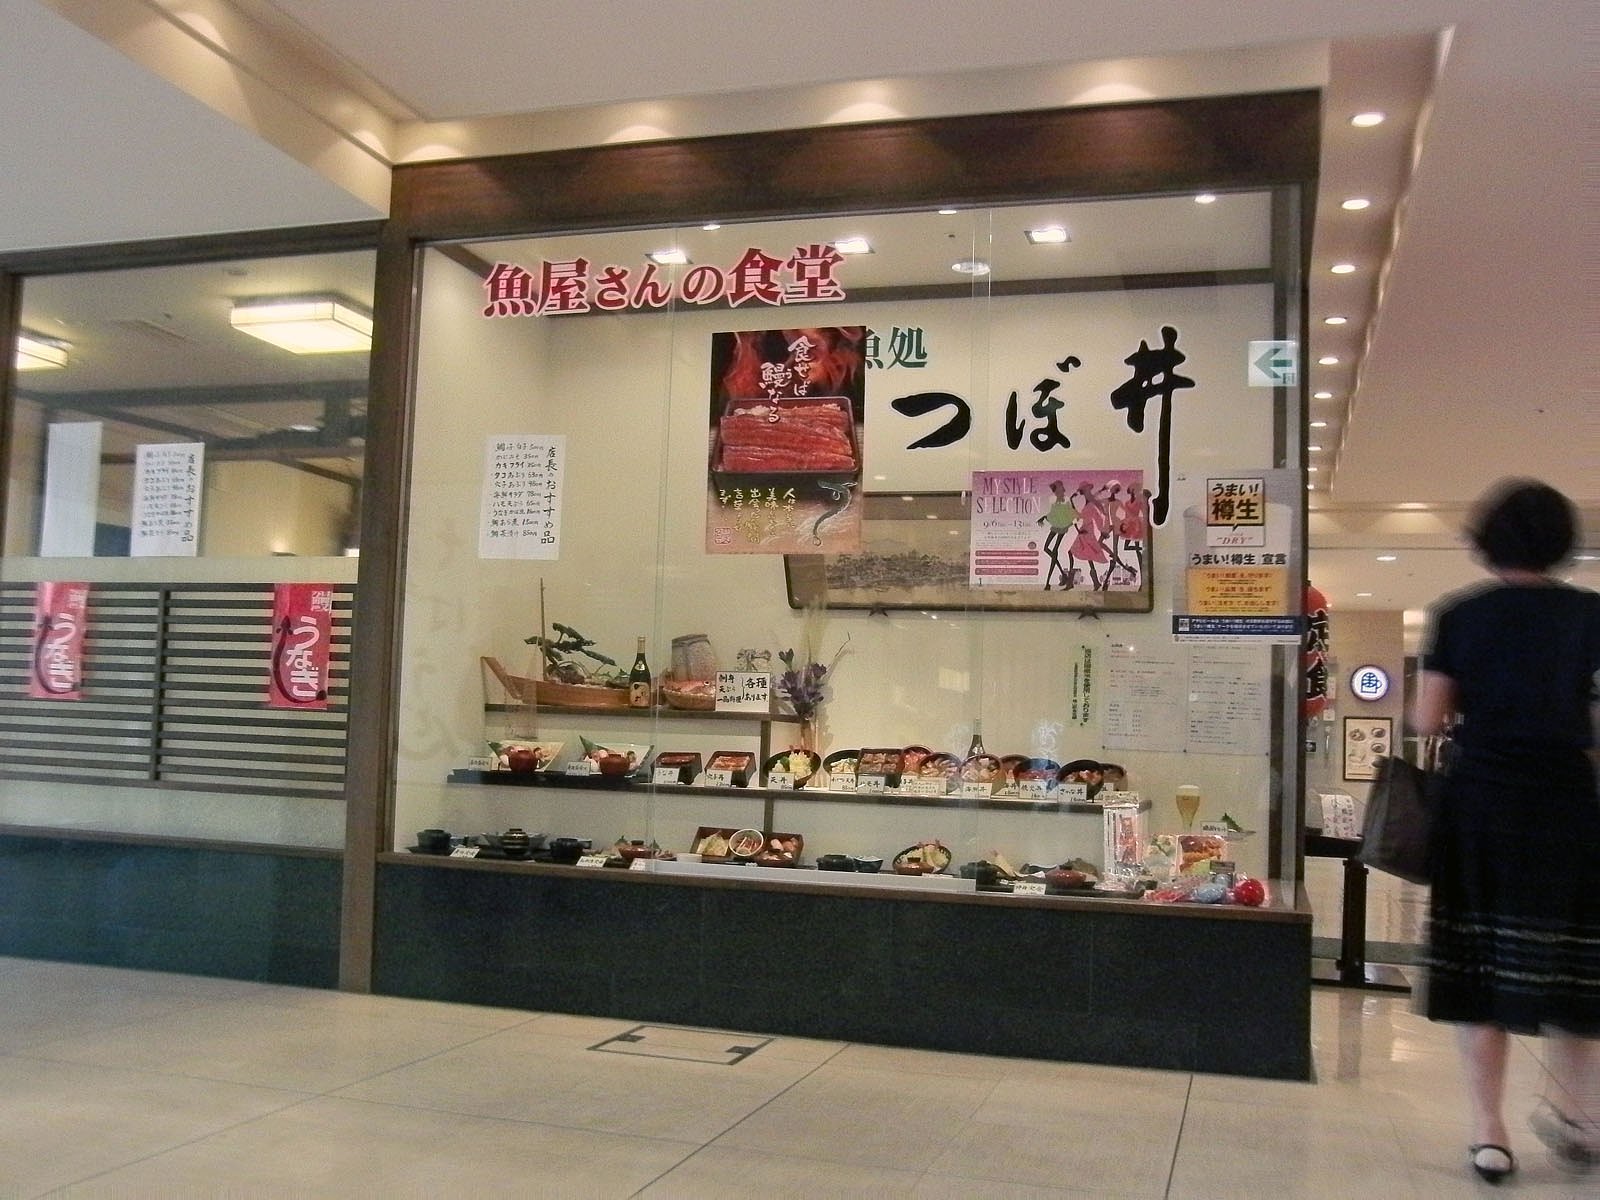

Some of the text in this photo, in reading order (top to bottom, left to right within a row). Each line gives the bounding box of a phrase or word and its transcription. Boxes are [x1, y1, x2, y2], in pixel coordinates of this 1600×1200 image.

[483, 244, 846, 317] 魚屋さんの食堂
[788, 335, 817, 396] 食せば
[759, 362, 788, 423] 鰻なる
[891, 326, 1195, 526] つぼ井
[496, 461, 525, 469] カキフライ
[541, 446, 558, 544] 店長のおすすめ品
[983, 476, 1038, 495] MY STYLE
[1212, 483, 1259, 498] うまい!
[976, 496, 1042, 514] SELECTION
[1212, 499, 1260, 521] 樽生
[1262, 553, 1288, 566] 宣言
[46, 612, 76, 689] うなぎ
[286, 615, 320, 698] うなぎ
[718, 673, 735, 683] 刺身
[745, 677, 768, 689] 各種
[769, 775, 787, 784] 天丼
